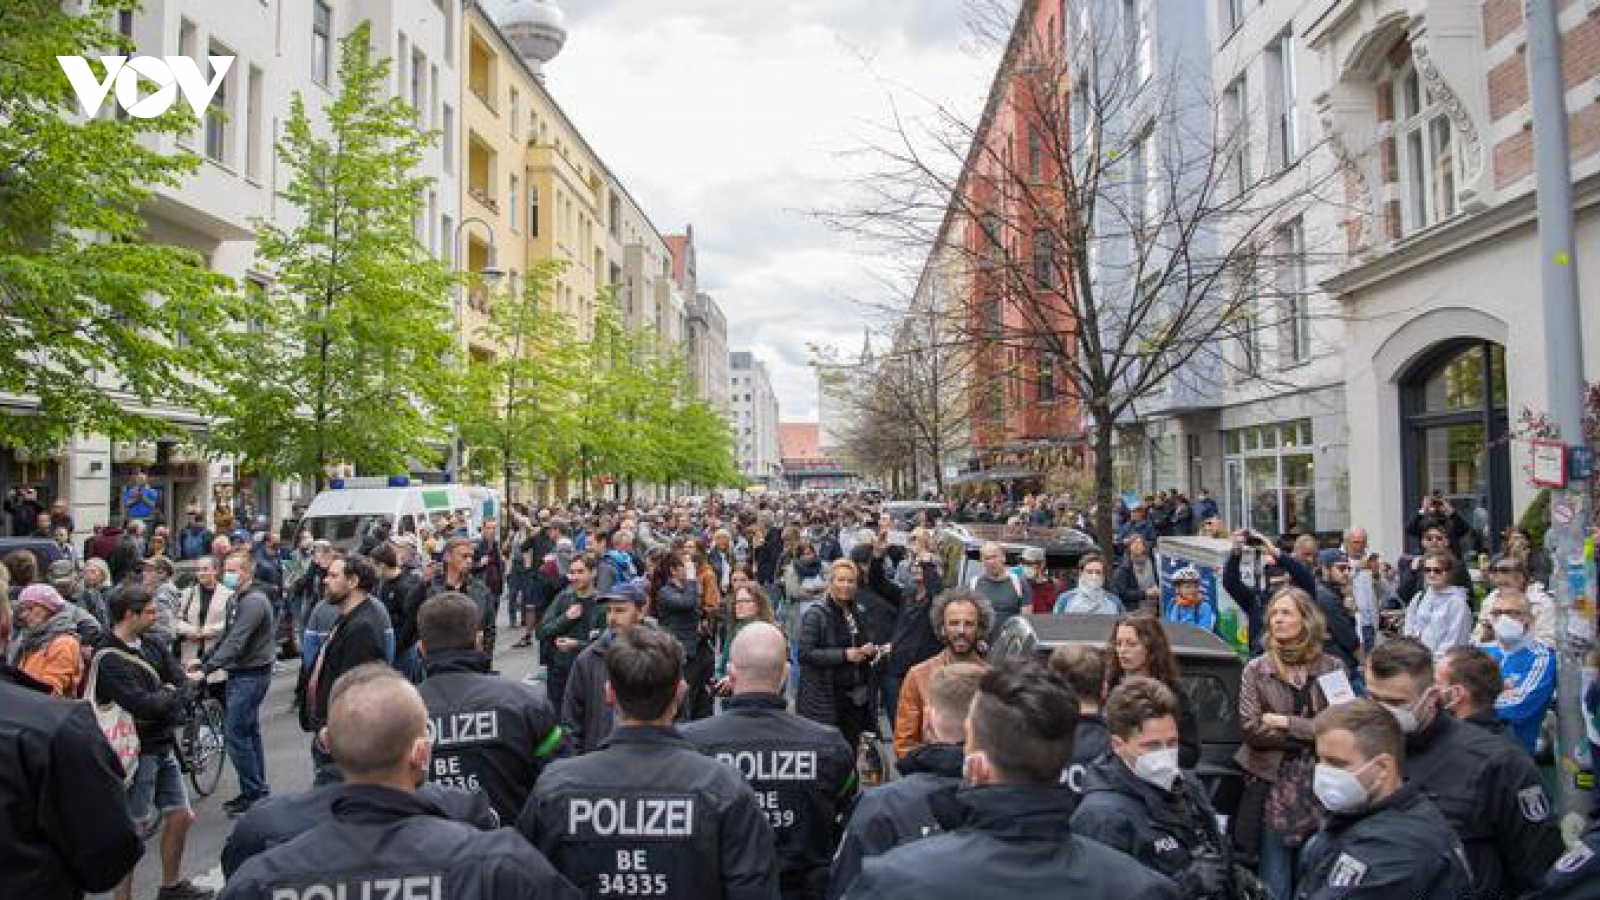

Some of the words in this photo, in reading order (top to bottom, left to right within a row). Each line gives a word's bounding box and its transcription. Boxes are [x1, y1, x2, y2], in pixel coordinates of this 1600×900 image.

[435, 757, 460, 776] BE
[568, 798, 693, 836] POLIZEI
[616, 849, 647, 870] BE
[598, 873, 668, 895] 34335
